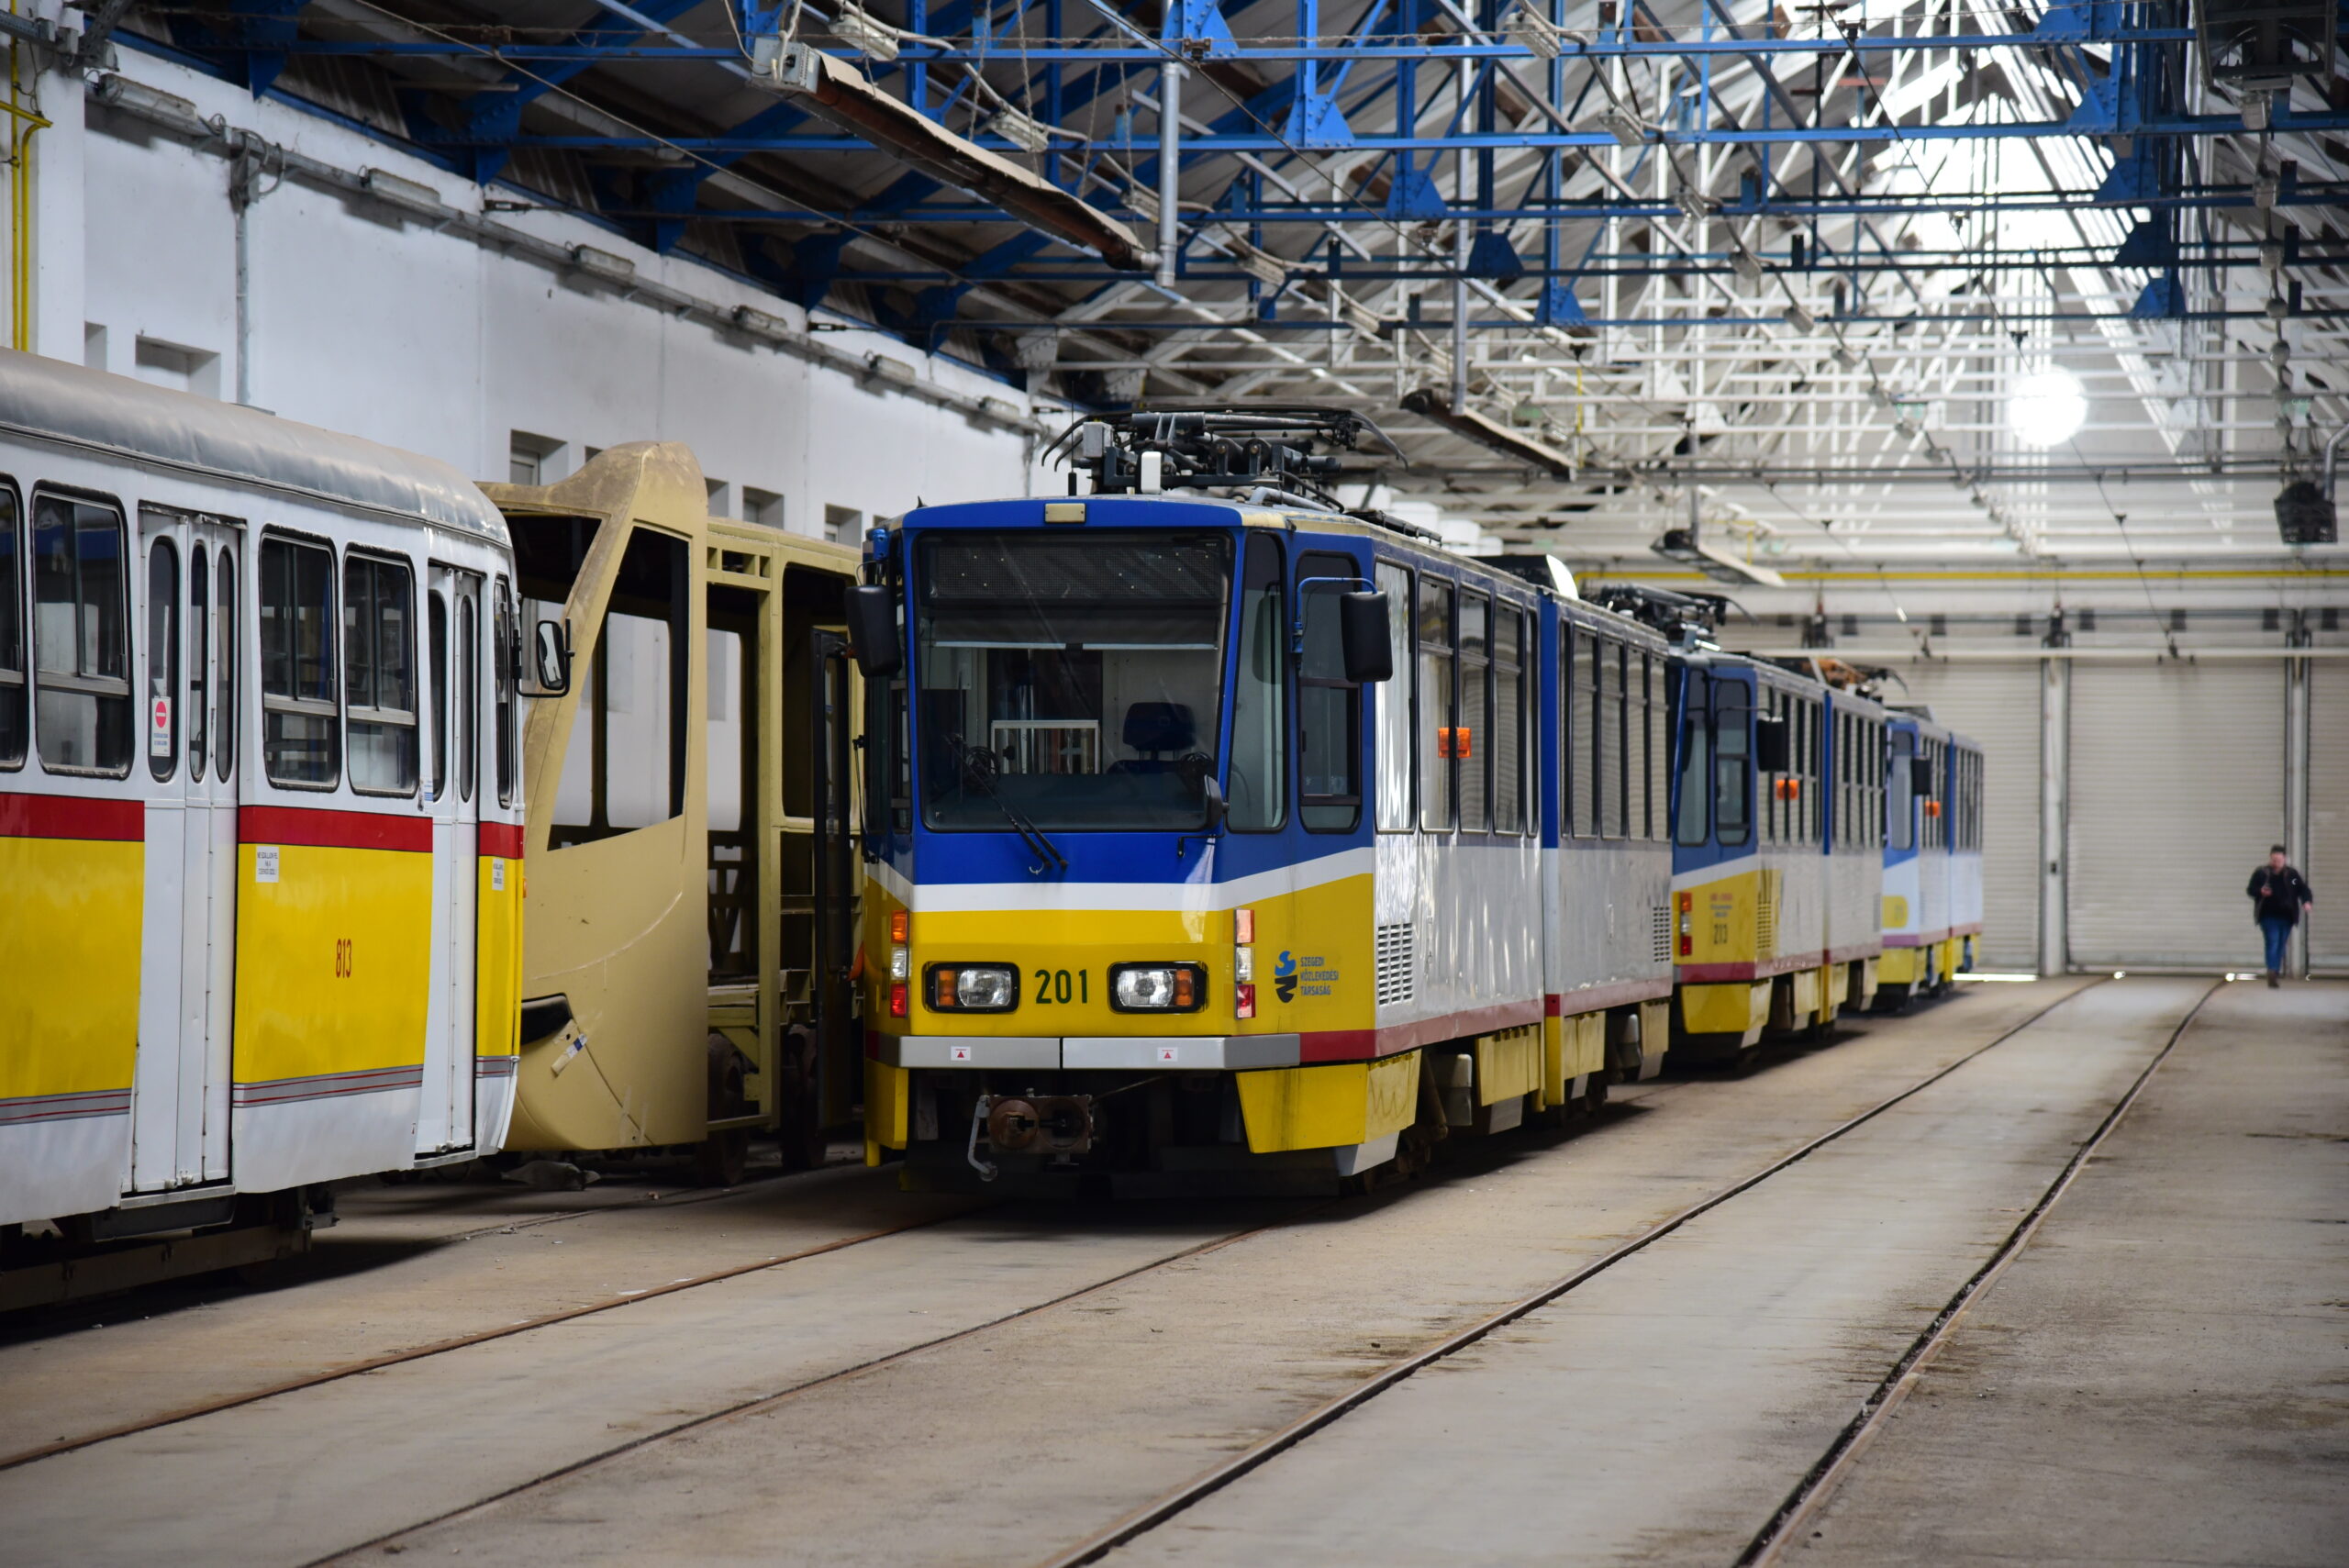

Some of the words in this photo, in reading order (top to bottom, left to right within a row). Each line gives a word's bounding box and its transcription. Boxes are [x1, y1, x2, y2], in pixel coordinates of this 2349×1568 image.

[336, 939, 351, 978] 813
[1300, 956, 1324, 967] SZEGEDI
[1035, 969, 1087, 1004] 201
